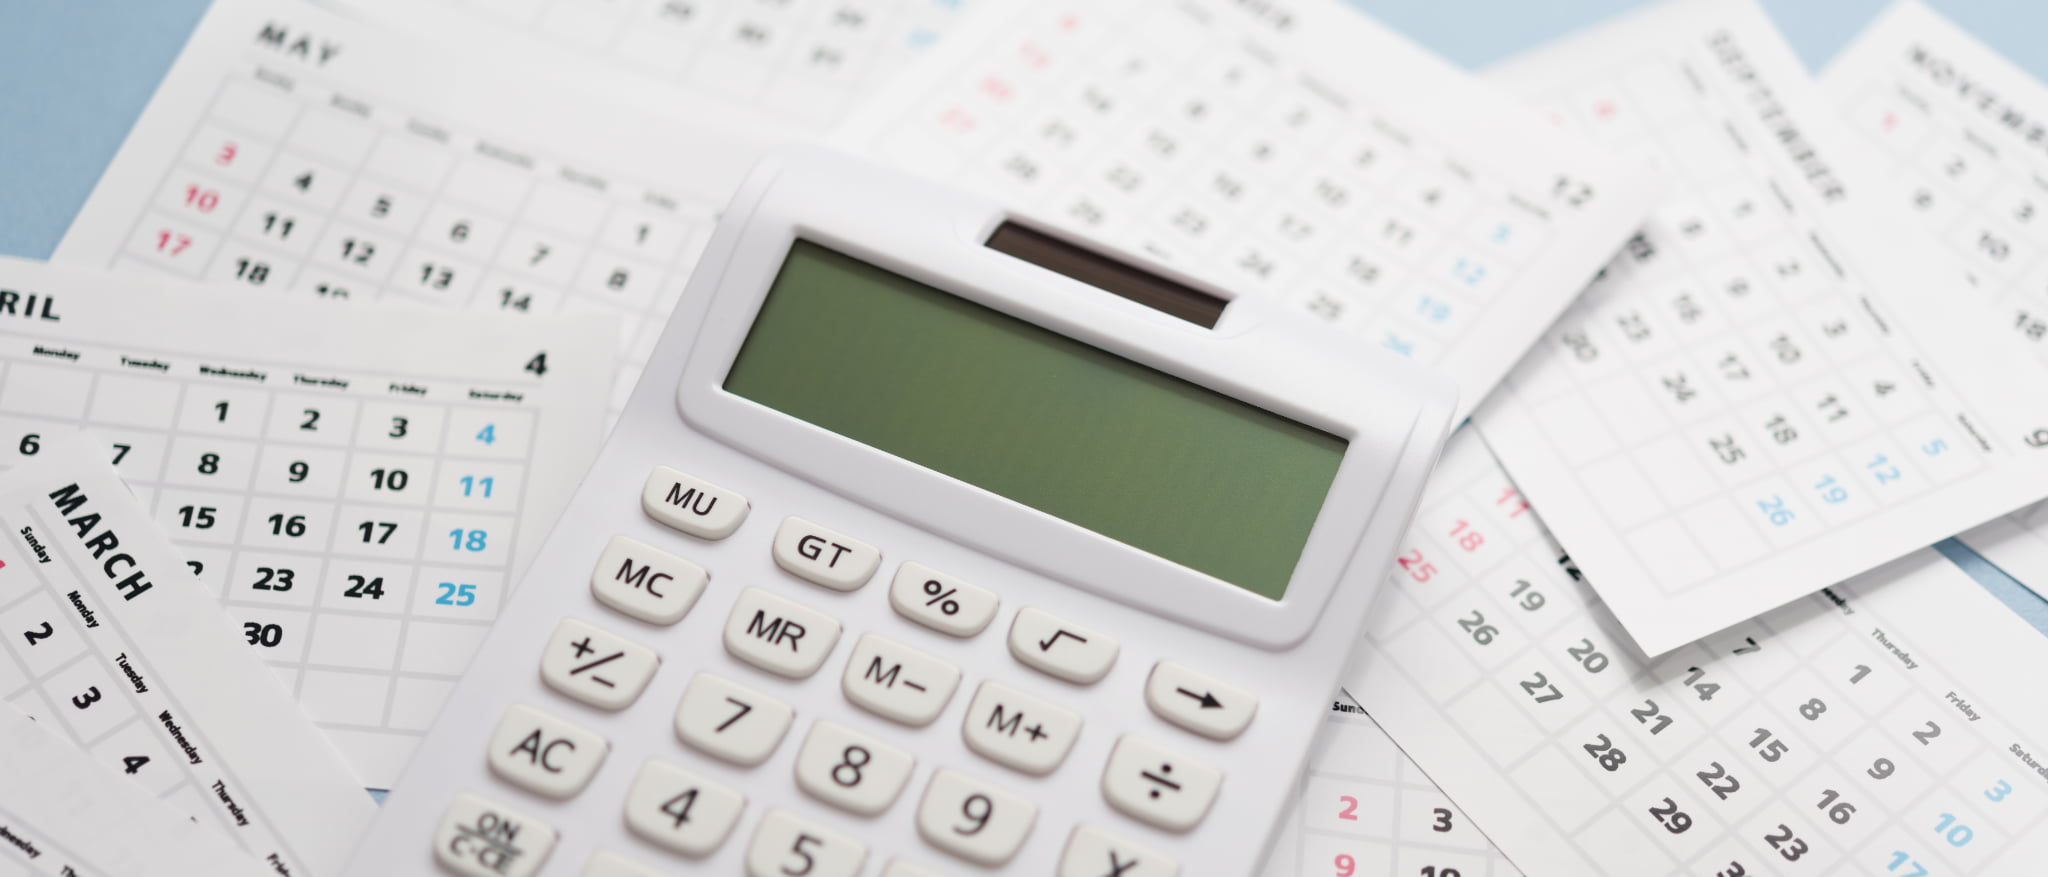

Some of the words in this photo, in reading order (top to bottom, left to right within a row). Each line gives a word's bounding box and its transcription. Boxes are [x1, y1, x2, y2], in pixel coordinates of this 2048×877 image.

[295, 172, 313, 192] 4
[158, 231, 191, 255] 17
[237, 259, 270, 284] 18
[186, 186, 219, 212] 10
[265, 214, 294, 237] 11
[343, 240, 375, 264] 12
[422, 265, 454, 288] 13
[501, 289, 531, 311] 14
[33, 346, 80, 360] Monday
[121, 357, 170, 371] Tuesday
[525, 353, 547, 376] 4
[215, 402, 229, 422] 1
[300, 410, 320, 430] 2
[389, 417, 408, 438] 3
[476, 424, 495, 444] 4
[19, 434, 40, 456] 6
[112, 444, 131, 465] 7
[198, 453, 220, 475] 8
[289, 462, 309, 482] 9
[370, 469, 408, 491] 10
[460, 476, 493, 498] 11
[1708, 434, 1746, 464] 25
[1867, 454, 1901, 485] 12
[665, 482, 717, 516] MU
[1814, 475, 1848, 504] 19
[1756, 496, 1795, 526] 26
[48, 483, 153, 601] MARCH
[179, 506, 216, 529] 15
[268, 514, 306, 537] 16
[359, 521, 398, 544] 17
[450, 529, 487, 552] 18
[1449, 519, 1484, 552] 18
[798, 535, 852, 568] GT
[923, 580, 959, 616] %
[1398, 549, 1437, 584] 25
[252, 567, 294, 591] 23
[344, 575, 384, 599] 24
[436, 583, 476, 606] 25
[1510, 580, 1545, 611] 19
[24, 622, 53, 646] 2
[244, 622, 282, 647] 30
[1457, 610, 1499, 645] 26
[615, 558, 673, 598] MC
[747, 610, 806, 652] MR
[987, 704, 1048, 741] M+
[1567, 638, 1609, 674] 20
[1732, 637, 1761, 657] 7
[21, 526, 51, 563] Sunday
[67, 590, 99, 628] Monday
[116, 653, 148, 693] Tuesday
[159, 710, 202, 764] Wednesday
[212, 780, 249, 826] Thursday
[1520, 672, 1564, 703] 27
[1682, 667, 1721, 702] 14
[1849, 665, 1872, 684] 1
[1871, 628, 1918, 670] Thursday
[1945, 691, 1981, 721] Friday
[72, 686, 101, 709] 3
[1799, 698, 1827, 721] 8
[1630, 699, 1673, 735] 21
[1912, 721, 1941, 746] 2
[509, 728, 575, 774] AC
[1583, 734, 1626, 771] 28
[1749, 728, 1789, 762] 15
[123, 756, 150, 774] 4
[715, 698, 752, 732] 7
[831, 745, 871, 788] 8
[954, 794, 993, 836] 9
[1696, 762, 1740, 800] 22
[1867, 758, 1895, 780] 9
[1817, 789, 1856, 824] 16
[1984, 779, 2012, 802] 3
[1339, 796, 1358, 820] 2
[1433, 808, 1452, 832] 3
[1649, 797, 1692, 834] 29
[1934, 813, 1973, 847] 10
[660, 788, 699, 829] 4
[781, 833, 823, 877] 5
[1764, 824, 1808, 862] 23
[1334, 854, 1355, 877] 9
[1888, 851, 1928, 877] 17
